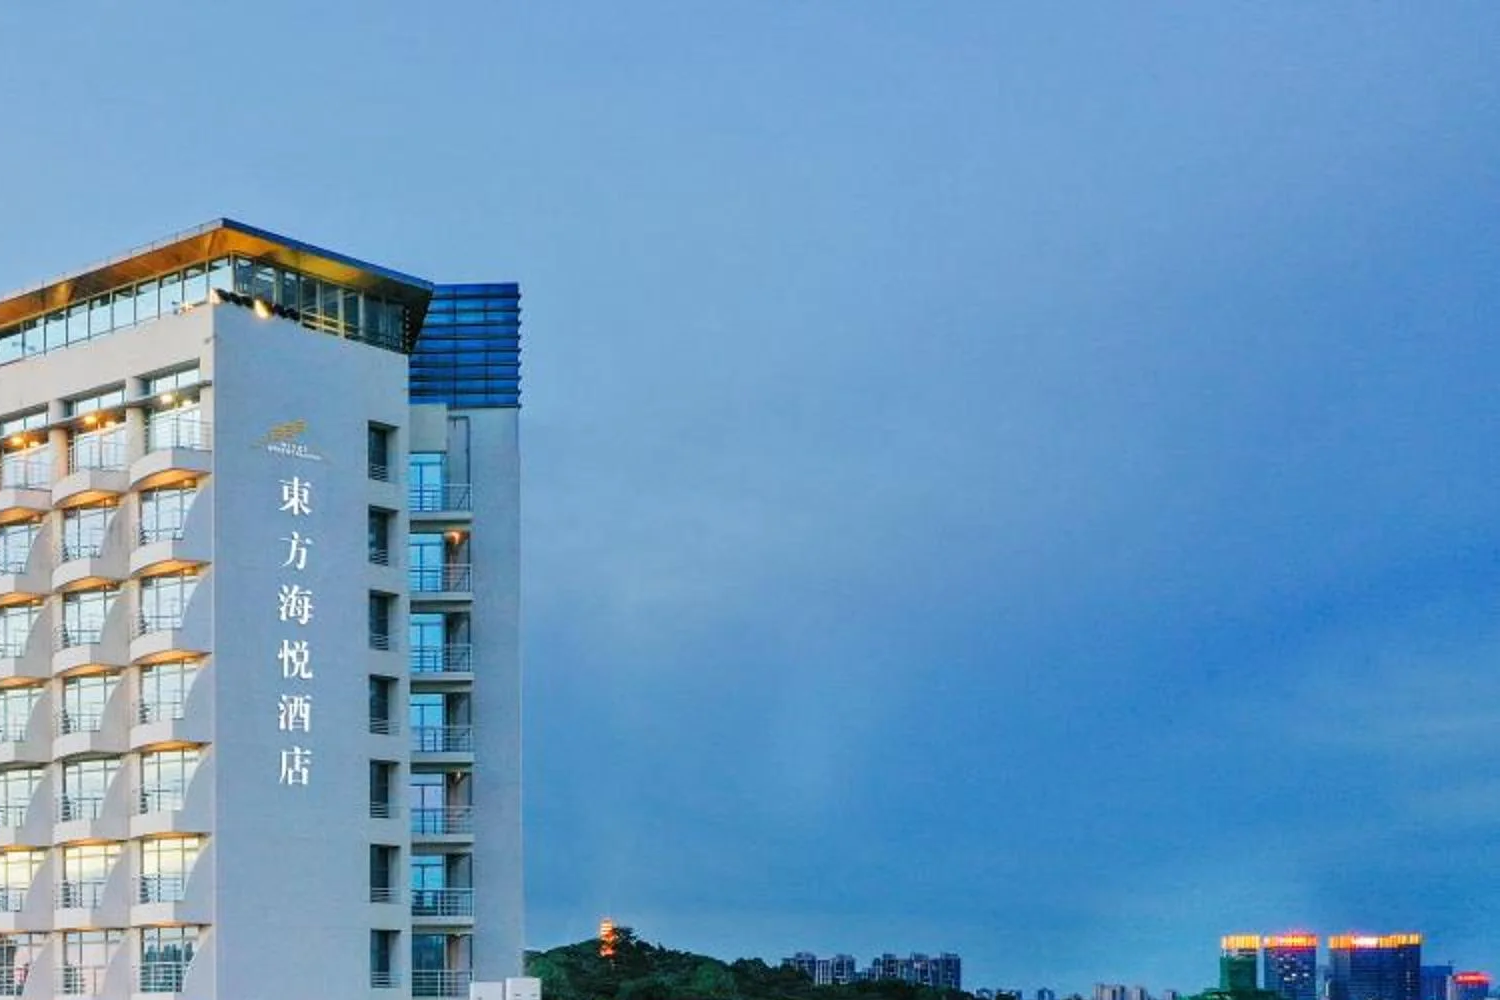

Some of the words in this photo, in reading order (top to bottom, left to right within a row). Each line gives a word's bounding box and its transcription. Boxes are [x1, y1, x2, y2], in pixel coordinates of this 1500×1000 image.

[277, 476, 314, 786] 東方海悦酒店
